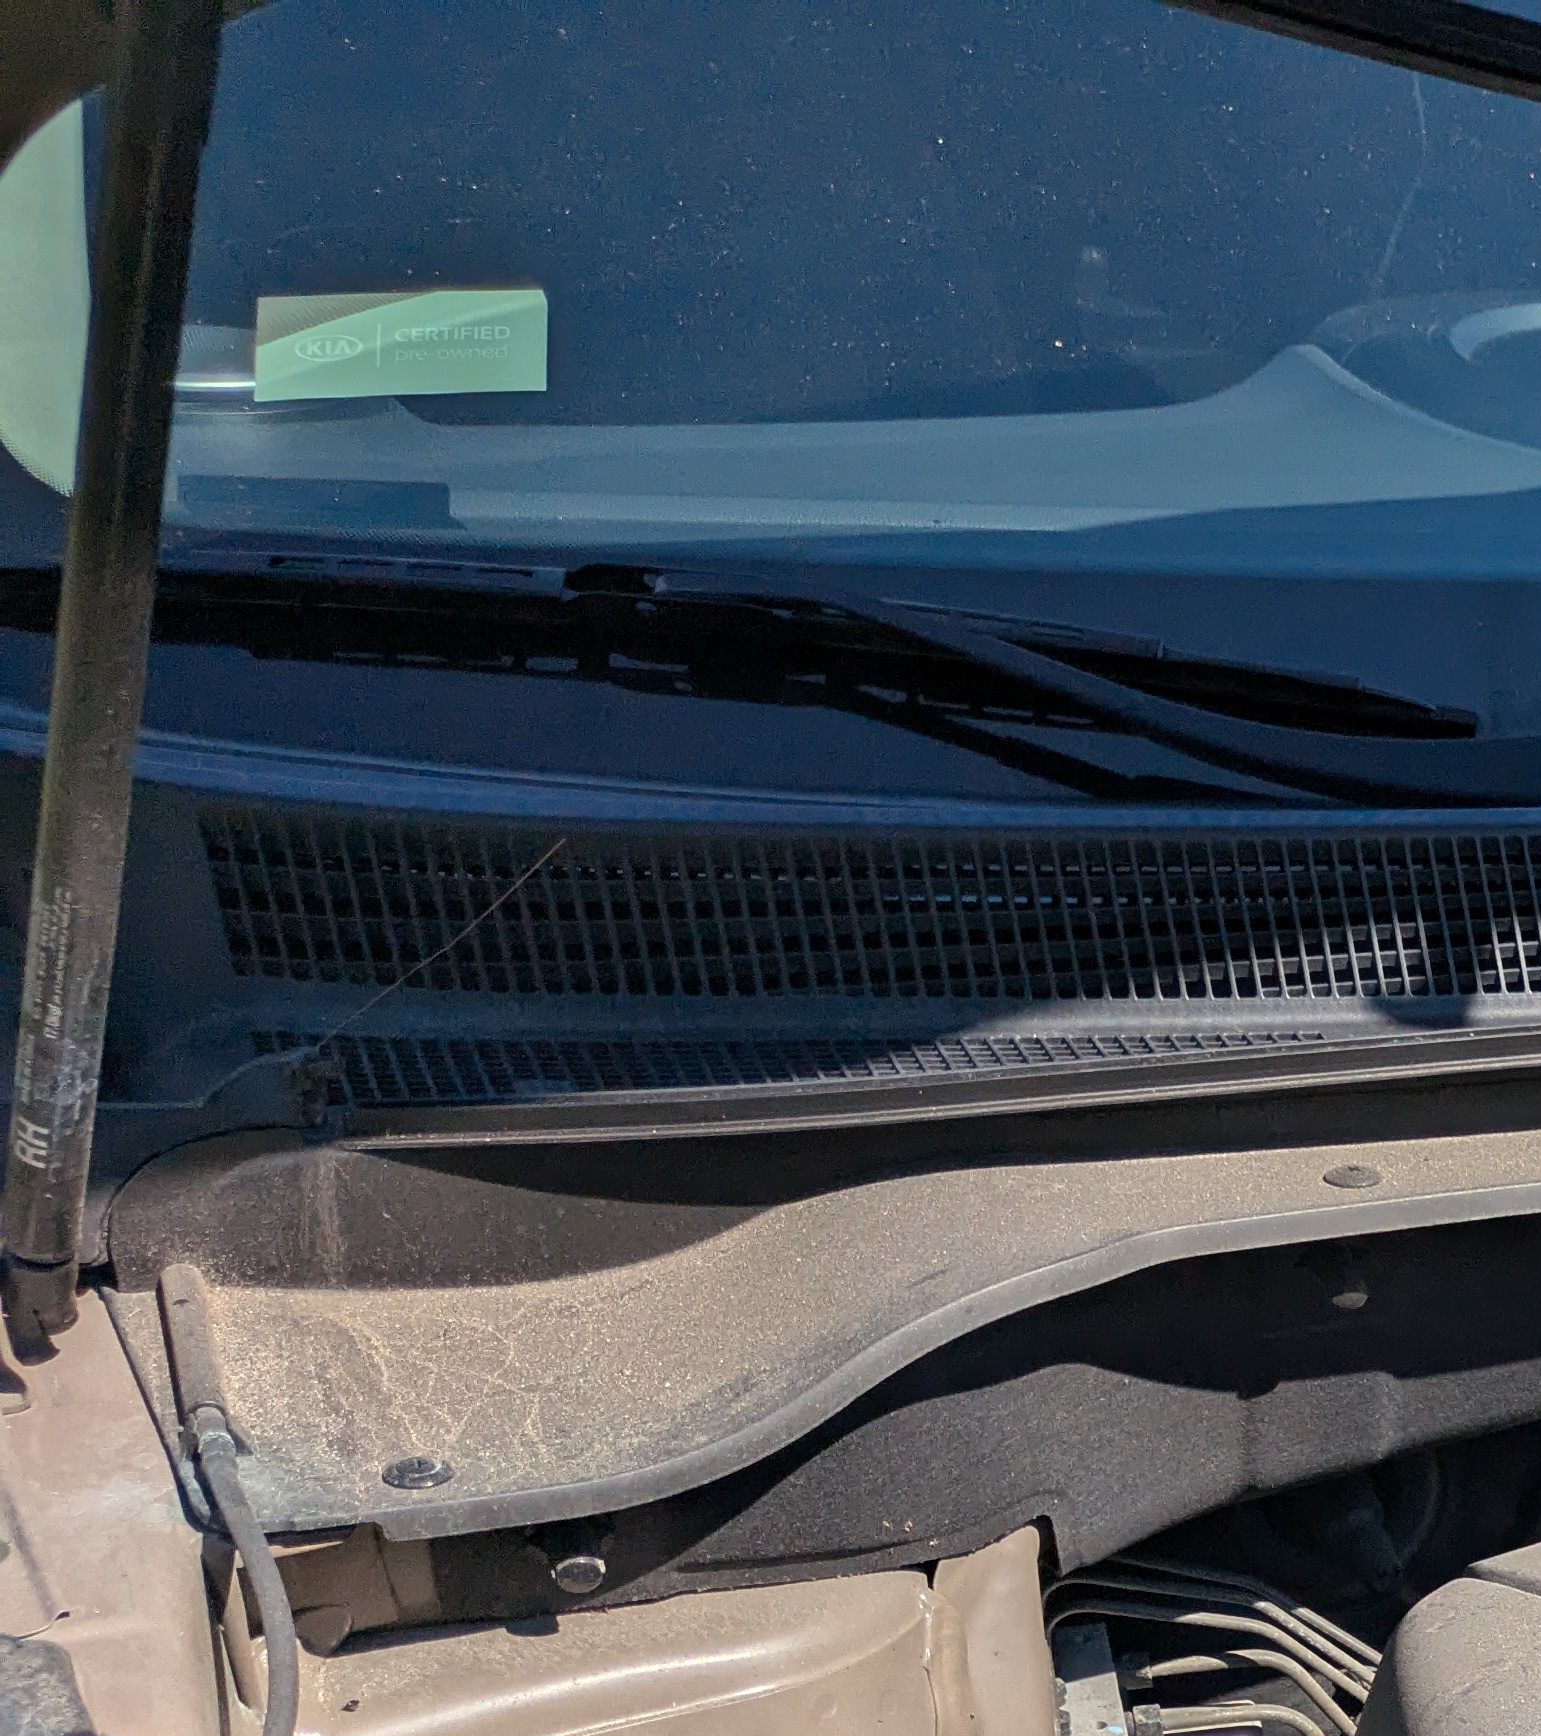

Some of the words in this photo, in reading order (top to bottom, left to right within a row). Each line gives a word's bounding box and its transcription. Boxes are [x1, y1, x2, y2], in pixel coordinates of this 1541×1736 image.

[394, 325, 511, 342] CERTIFIED
[305, 340, 351, 357] KIA
[394, 346, 508, 362] pre-owned
